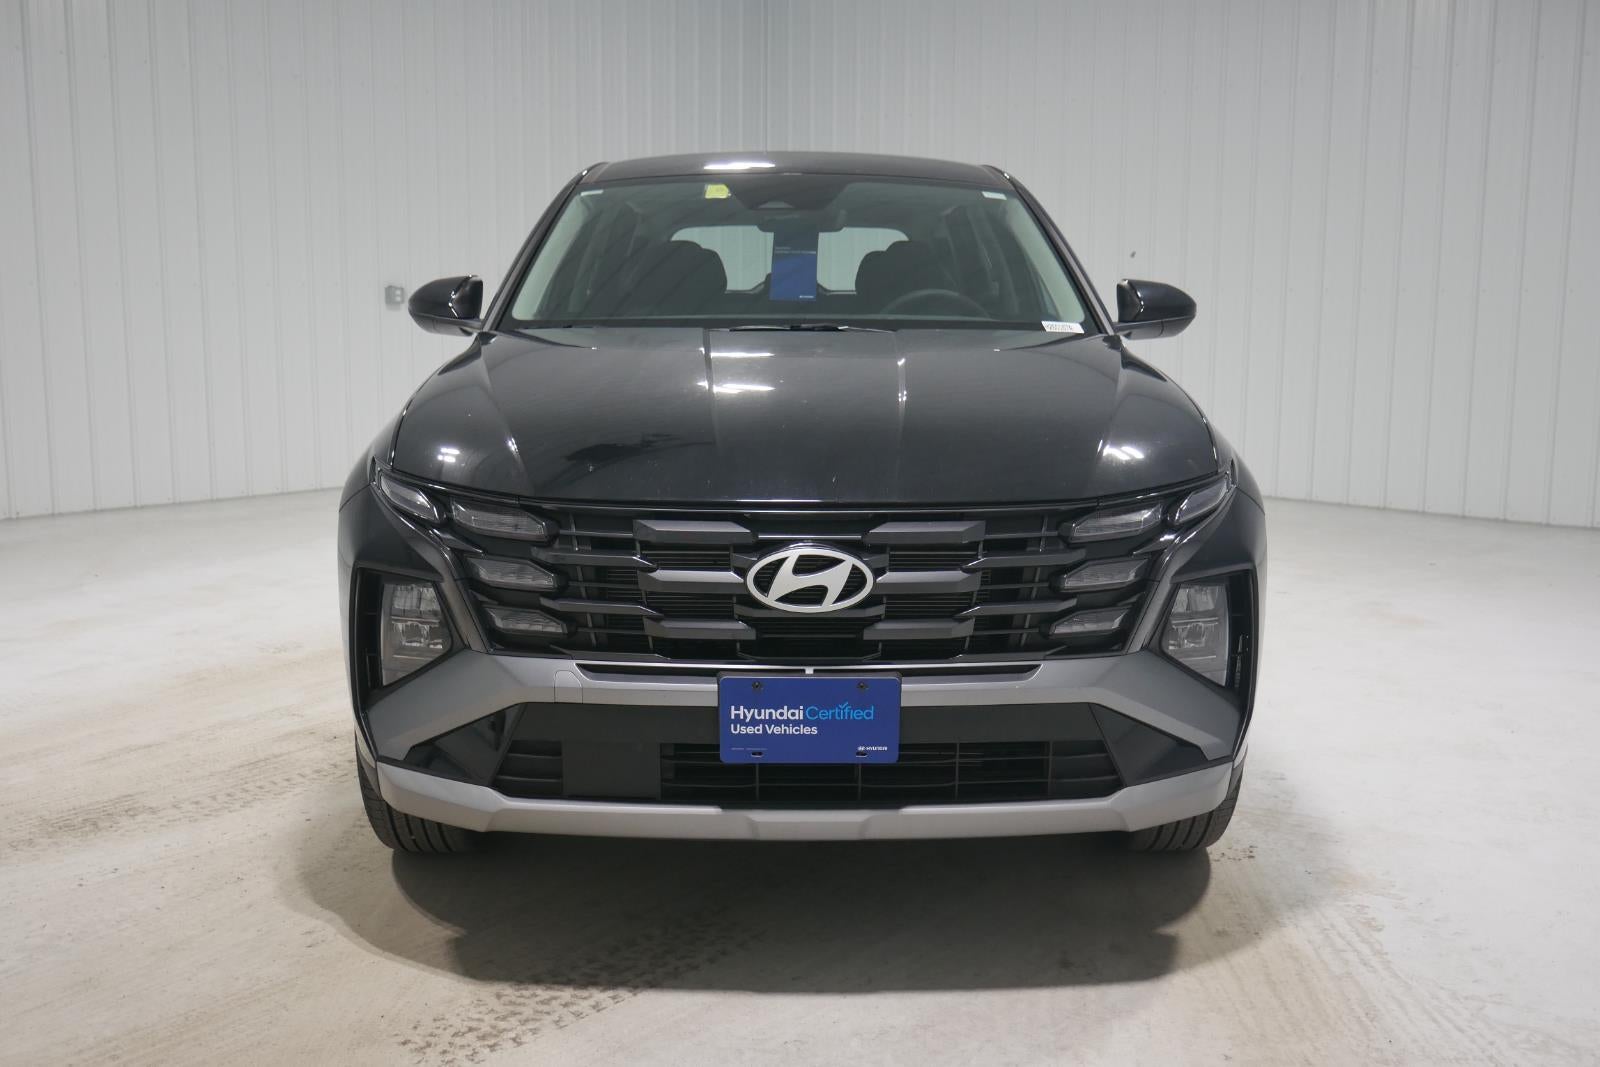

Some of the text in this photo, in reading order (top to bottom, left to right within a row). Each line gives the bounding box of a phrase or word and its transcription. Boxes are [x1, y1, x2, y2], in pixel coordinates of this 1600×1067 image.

[730, 702, 874, 723] Hyundai Certified
[730, 724, 818, 735] Used Vehicles
